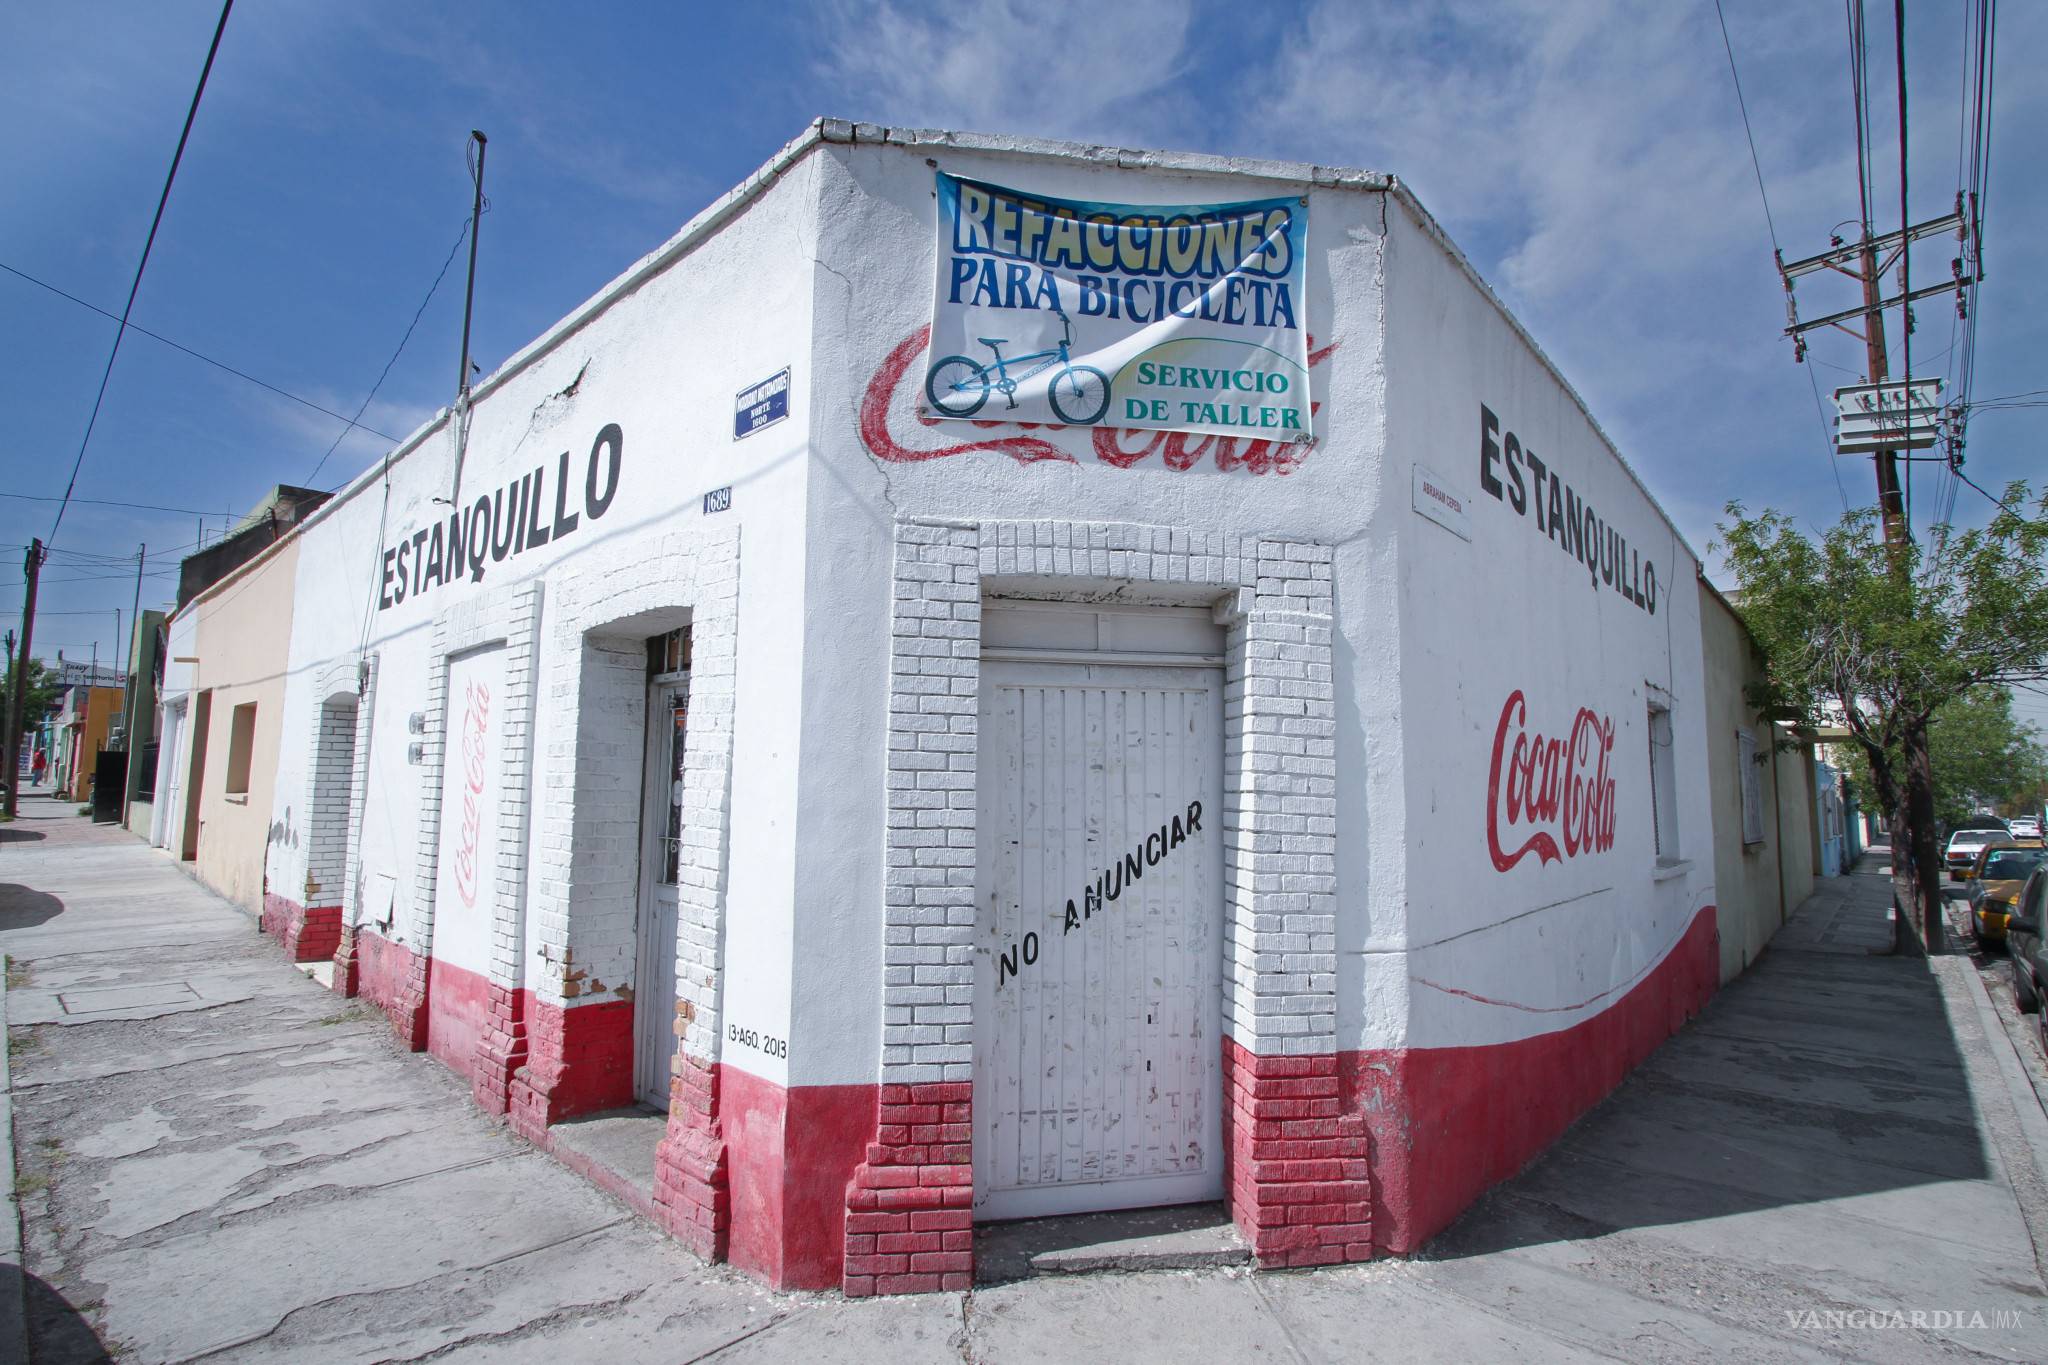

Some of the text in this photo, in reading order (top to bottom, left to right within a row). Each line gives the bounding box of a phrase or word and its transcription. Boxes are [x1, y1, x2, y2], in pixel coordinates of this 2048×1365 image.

[953, 180, 1293, 280] REFACCIONES
[948, 256, 1297, 330] PARA BICICLETA
[1136, 361, 1290, 394] SERVICIO
[750, 400, 771, 420] NORTE
[751, 414, 768, 429] 1600
[1124, 398, 1302, 430] DE TALLER
[378, 422, 624, 612] ESTANQUILLO
[705, 488, 730, 514] 1689
[1480, 401, 1656, 616] ESTANQUILLO
[1000, 800, 1203, 987] NO ANUNCIAR
[763, 1035, 787, 1060] 2013
